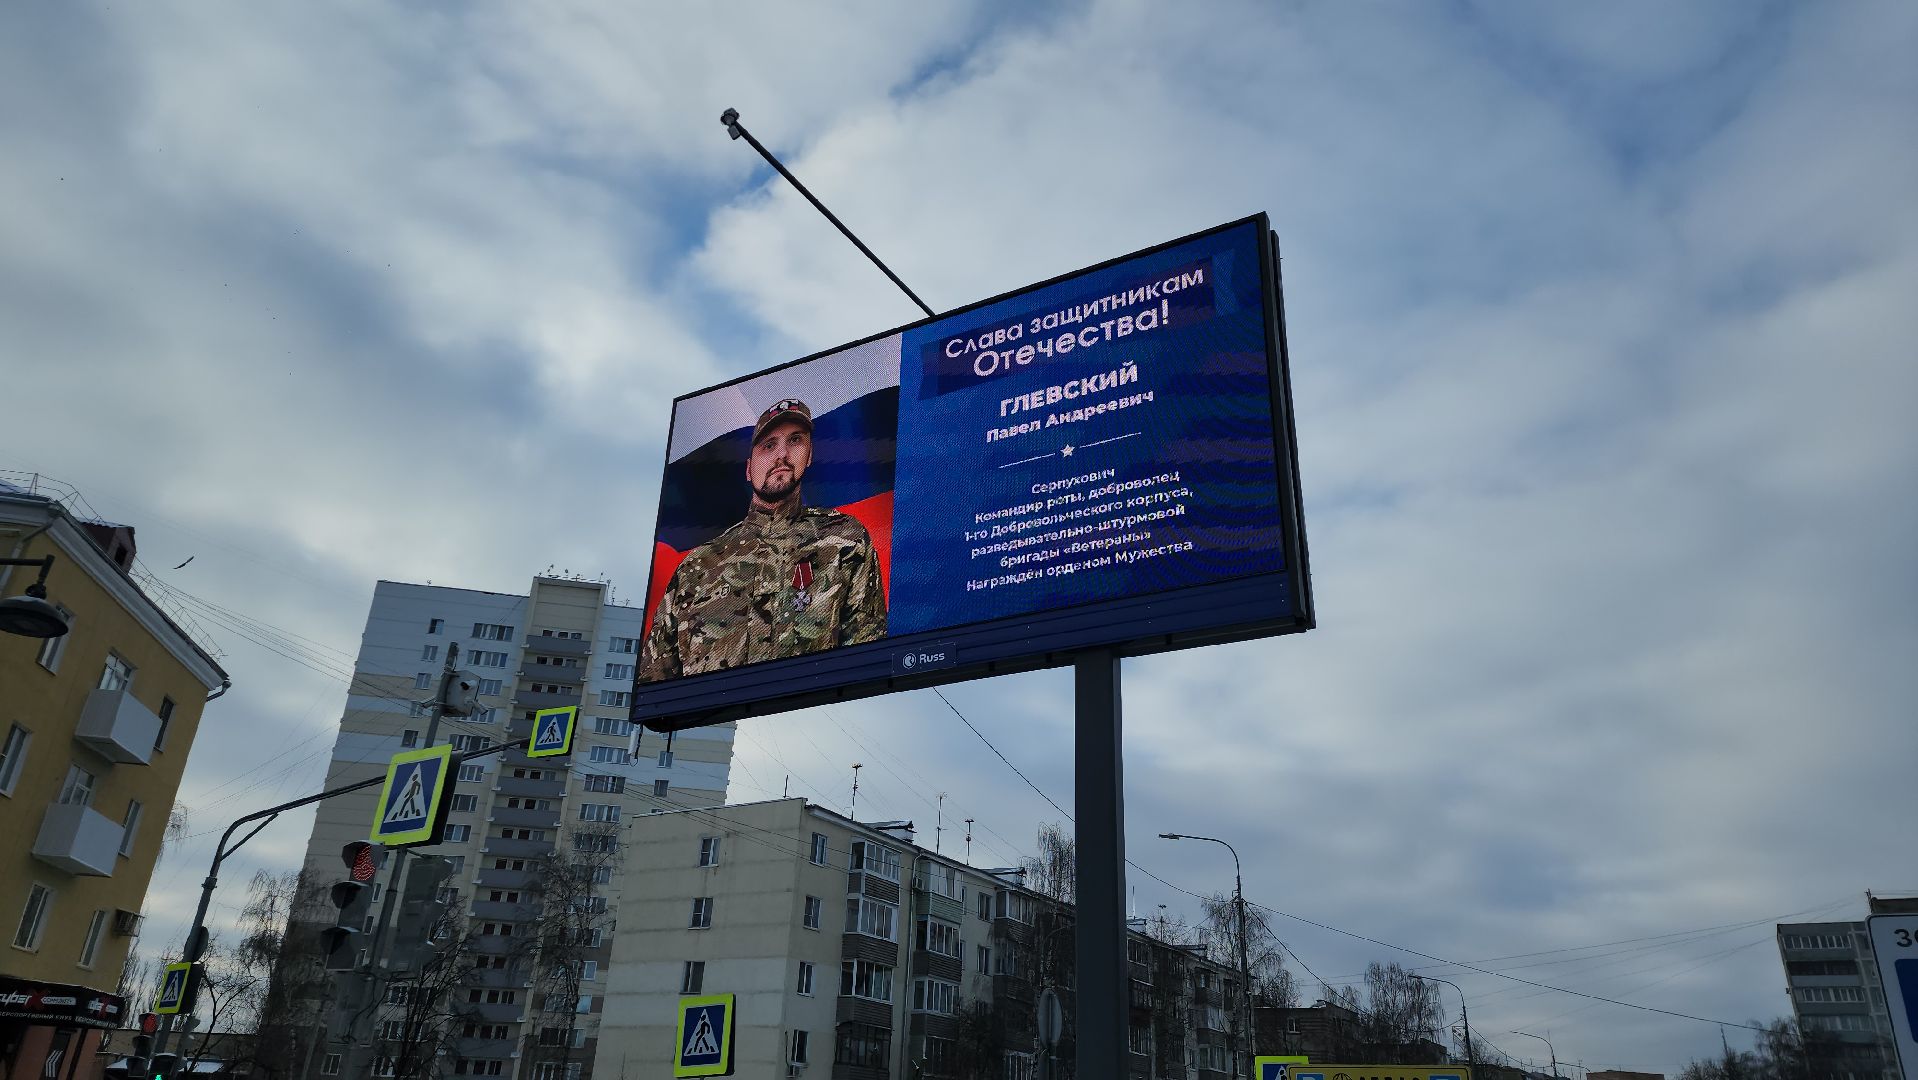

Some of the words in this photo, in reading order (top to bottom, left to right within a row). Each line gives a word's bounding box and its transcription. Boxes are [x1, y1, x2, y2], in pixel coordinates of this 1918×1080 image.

[945, 322, 1023, 358] Слава
[1029, 268, 1204, 334] защитникам
[973, 298, 1169, 377] Отечества!
[1000, 359, 1138, 417] ГЛЕВСКИЙ
[986, 419, 1041, 443] Павел
[1045, 390, 1154, 428] Андреевич
[975, 502, 1044, 524] Командир
[1046, 492, 1086, 510] роты,
[1088, 470, 1181, 500] доброволец
[1031, 468, 1115, 494] Серпухович
[964, 529, 989, 541] 1-го
[990, 501, 1123, 539] Добровольческого
[1126, 487, 1194, 507] корпуса,
[971, 503, 1186, 560] разведывательно-штурмовой
[966, 568, 1043, 591] Награждён
[1046, 556, 1111, 577] орденом
[1115, 541, 1193, 564] Мужества
[1000, 548, 1060, 568] бригады
[1063, 531, 1151, 554] «Ветераны»
[919, 652, 945, 664] Russ
